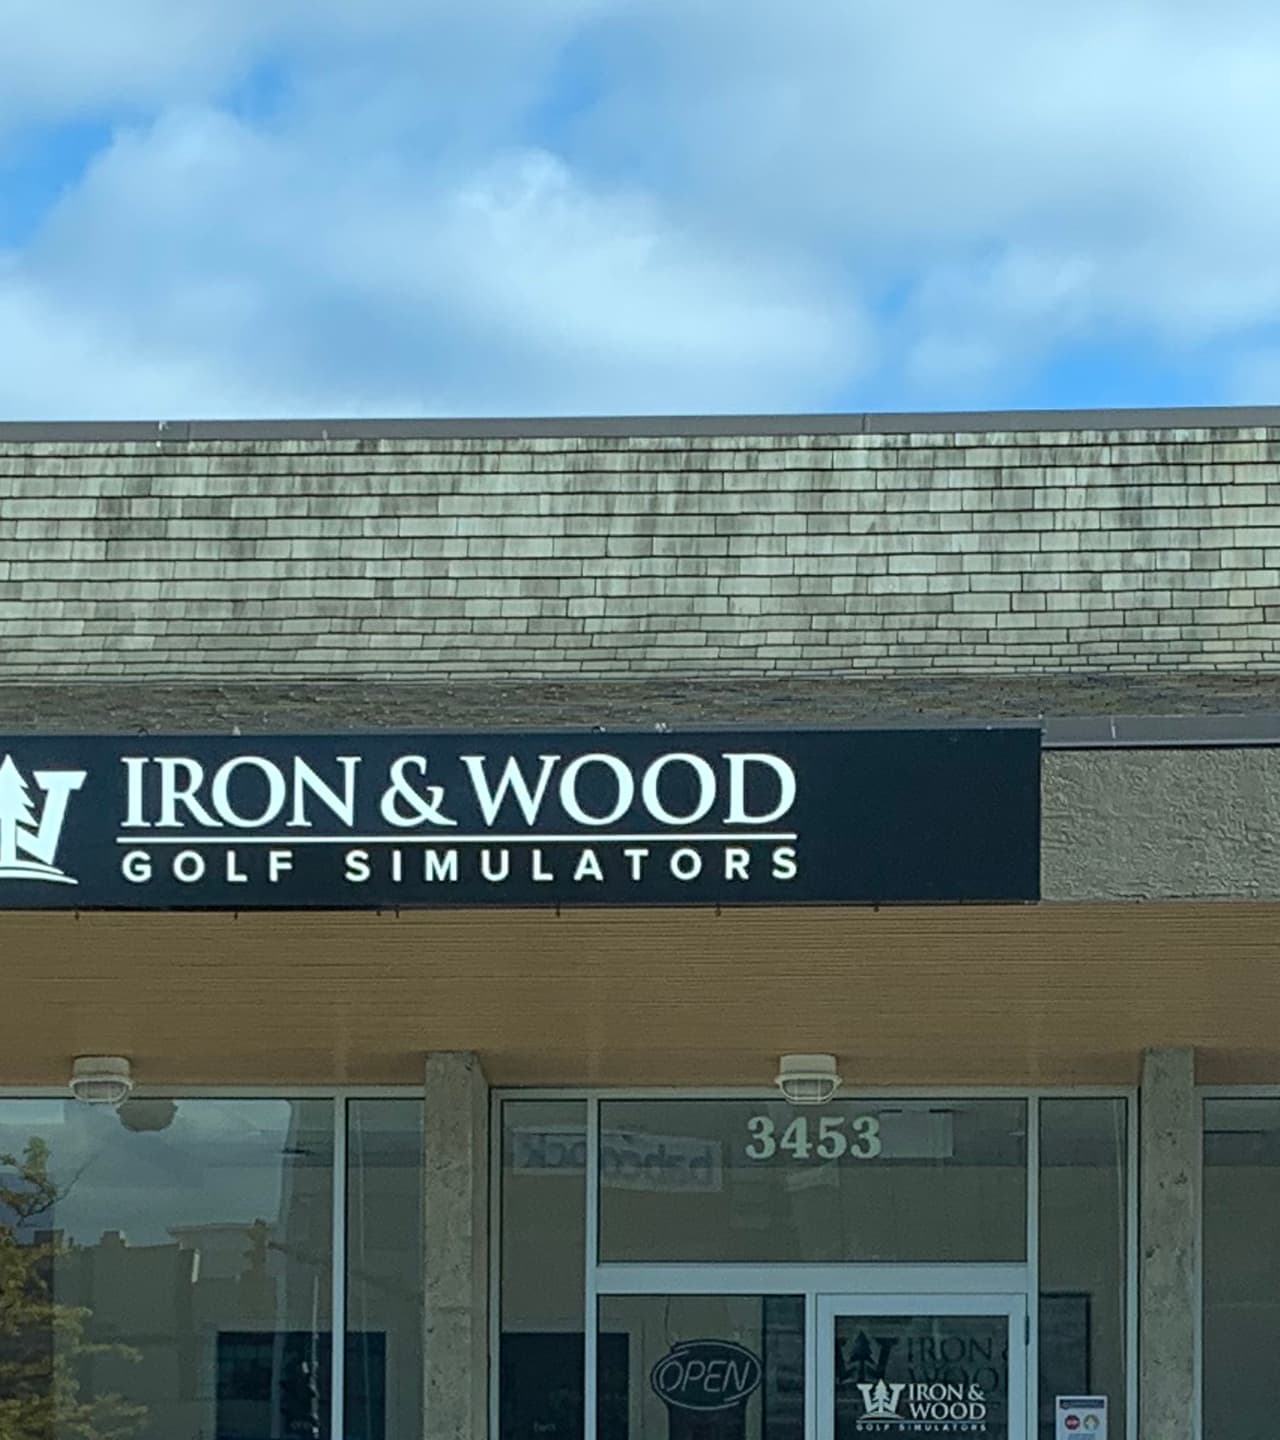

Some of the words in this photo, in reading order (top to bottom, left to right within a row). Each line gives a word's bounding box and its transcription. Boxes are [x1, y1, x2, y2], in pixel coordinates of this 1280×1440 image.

[120, 755, 363, 828] IRON
[380, 755, 458, 828] &
[459, 752, 797, 827] WOOD
[121, 850, 293, 883] GOLF
[344, 847, 798, 883] SIMULATORS
[745, 1116, 882, 1160] 3453
[659, 1360, 751, 1393] OPEN
[907, 1383, 964, 1401] IRON
[967, 1383, 987, 1401] &
[856, 1423, 890, 1432] GOLF
[898, 1423, 987, 1432] SIMULATORS
[909, 1402, 987, 1420] WOOD
